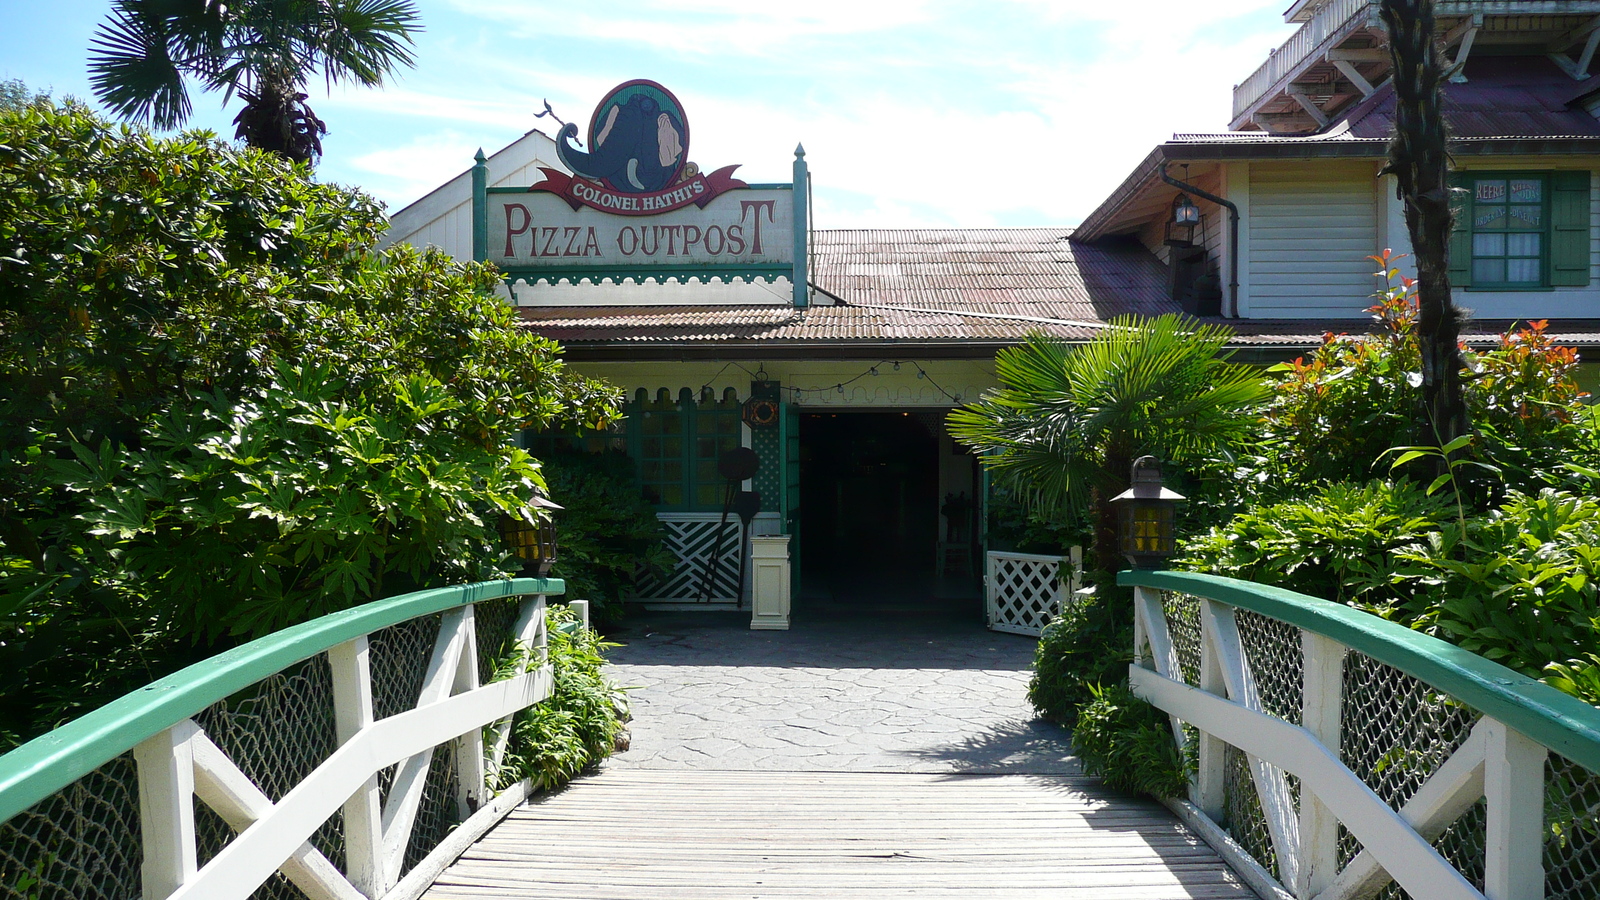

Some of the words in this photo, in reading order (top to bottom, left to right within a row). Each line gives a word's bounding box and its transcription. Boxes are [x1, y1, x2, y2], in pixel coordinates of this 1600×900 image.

[572, 182, 641, 211] COLONEL
[642, 180, 705, 211] HATHI'S
[503, 202, 602, 257] PIZZA
[616, 199, 776, 256] OUTPOST
